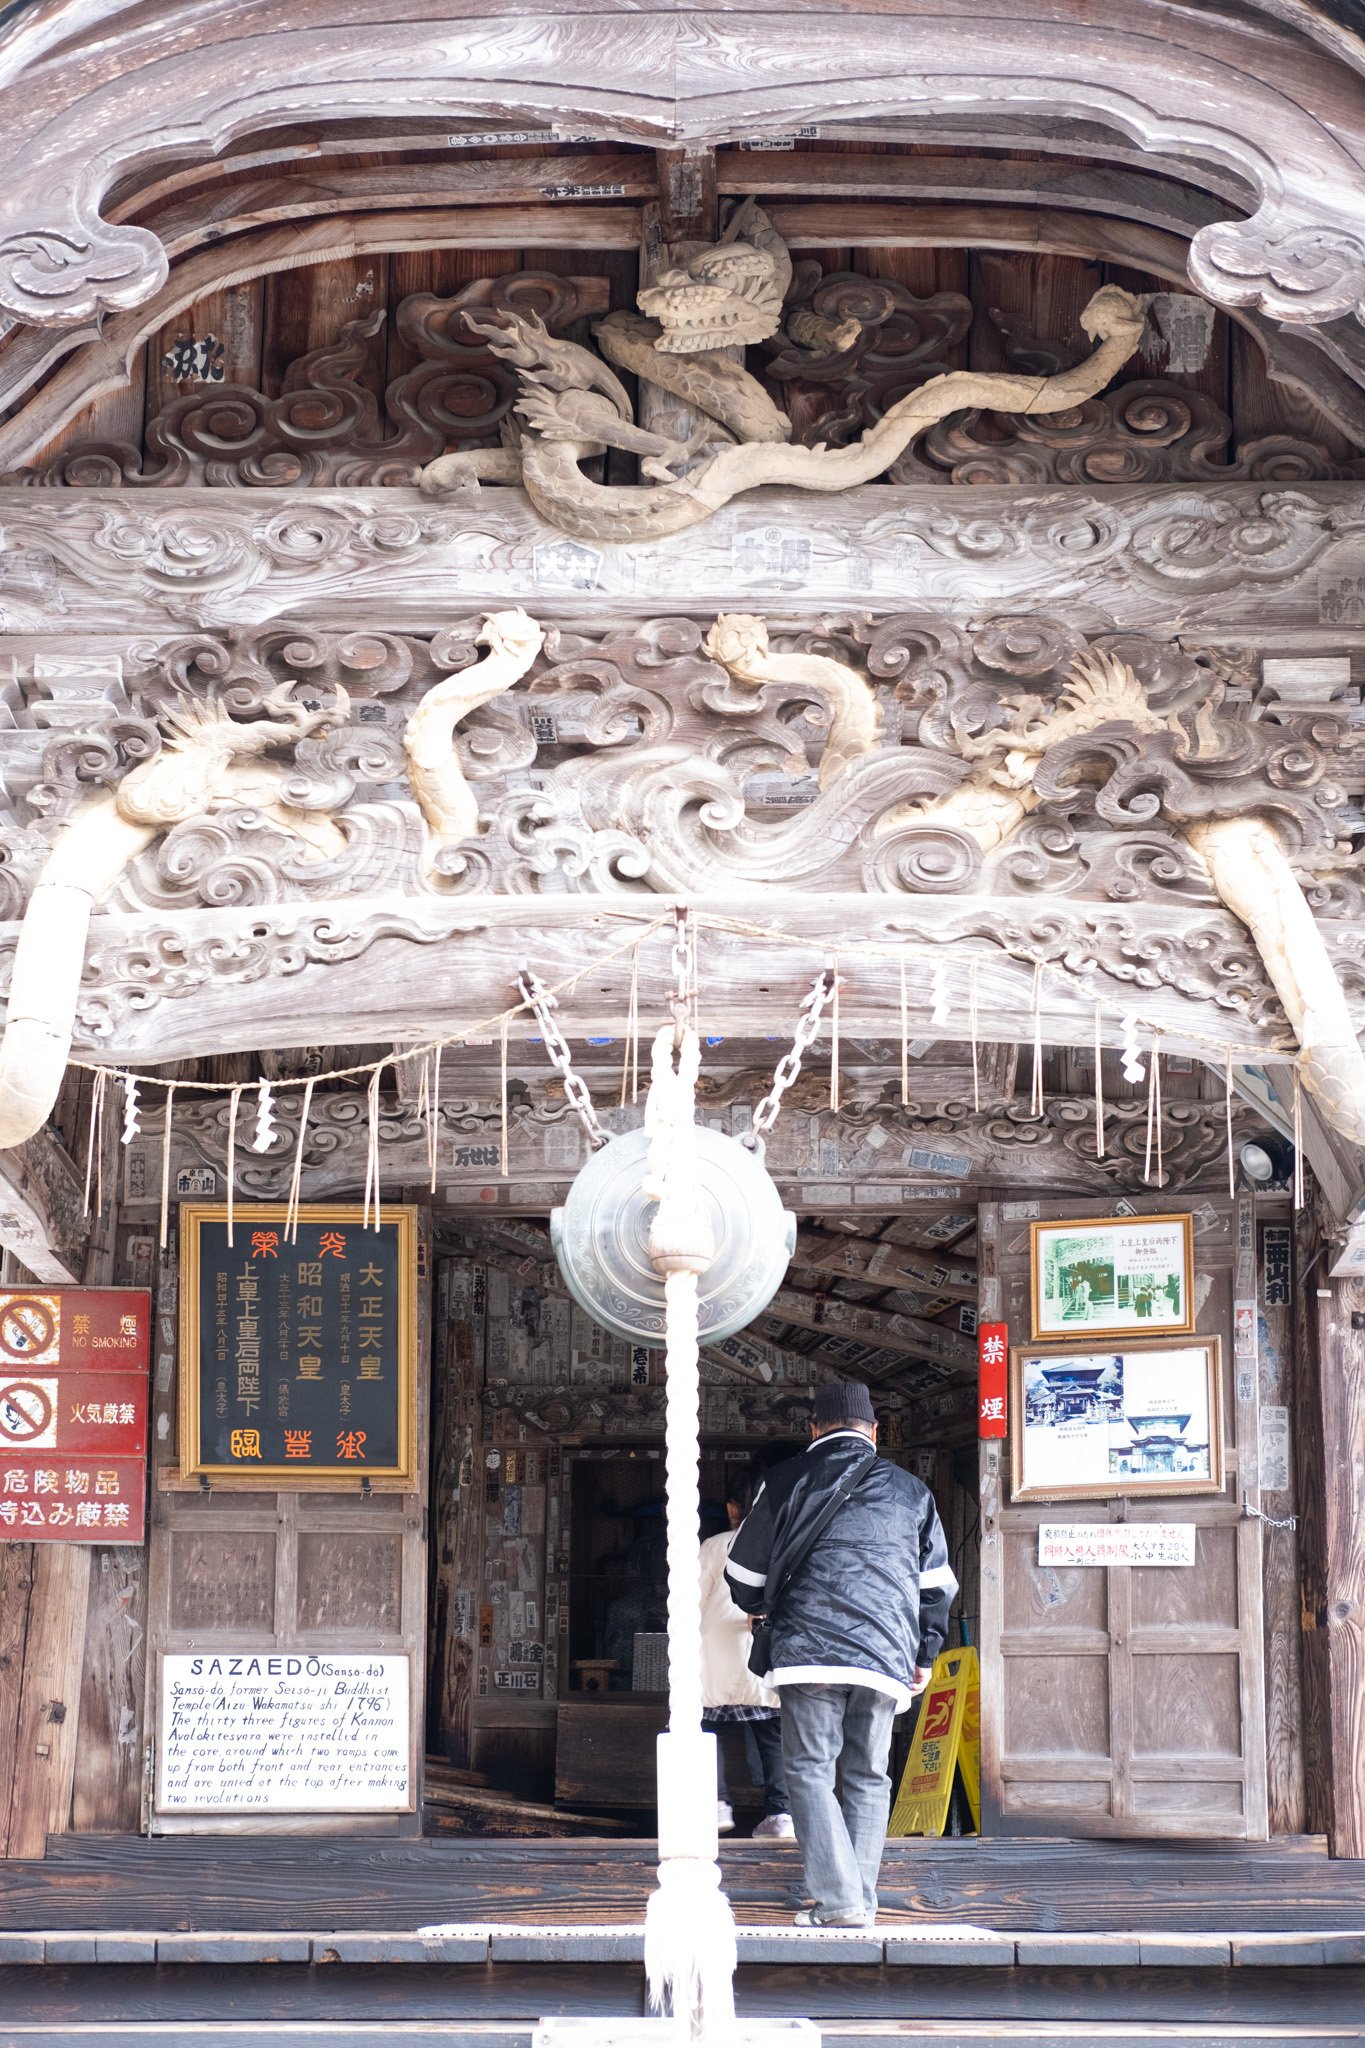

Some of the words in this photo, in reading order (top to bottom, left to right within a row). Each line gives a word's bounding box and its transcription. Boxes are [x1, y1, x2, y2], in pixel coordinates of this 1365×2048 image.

[72, 1314, 137, 1336] 禁煙
[296, 1262, 325, 1381] 昭和天皇
[356, 1262, 385, 1381] 大正天皇
[72, 1337, 88, 1348] NO
[92, 1337, 137, 1349] SMOKING
[234, 1261, 261, 1417] 上皇上皇后両陛下
[980, 1334, 1005, 1421] 禁煙
[70, 1403, 135, 1425] 火気厳禁
[3, 1469, 120, 1495] 危険物品
[230, 1681, 269, 1696] former
[334, 1681, 390, 1695] Buddhist
[172, 1712, 191, 1726] The
[197, 1712, 237, 1727] thirty
[243, 1712, 275, 1725] three
[280, 1712, 326, 1728] figures
[333, 1712, 347, 1727] of
[350, 1712, 394, 1726] Kannon
[168, 1727, 261, 1741] Avalokitesvara
[268, 1733, 293, 1741] were
[301, 1728, 360, 1741] installed
[365, 1733, 378, 1741] in
[168, 1743, 187, 1756] the
[225, 1743, 268, 1756] around
[271, 1743, 303, 1756] which
[312, 1747, 330, 1756] two
[337, 1748, 367, 1758] ramps
[168, 1764, 181, 1774] up
[185, 1759, 214, 1773] from
[218, 1758, 245, 1772] both
[250, 1758, 284, 1773] front
[290, 1759, 312, 1771] and
[318, 1763, 342, 1771] rear
[349, 1762, 408, 1772] entrances
[167, 1774, 190, 1787] and
[194, 1780, 213, 1788] are
[258, 1778, 272, 1786] at
[279, 1774, 298, 1786] the
[304, 1778, 323, 1789] top
[329, 1774, 362, 1789] after
[368, 1774, 408, 1791] making
[168, 1794, 187, 1803] two
[194, 1789, 270, 1803] revolutions
